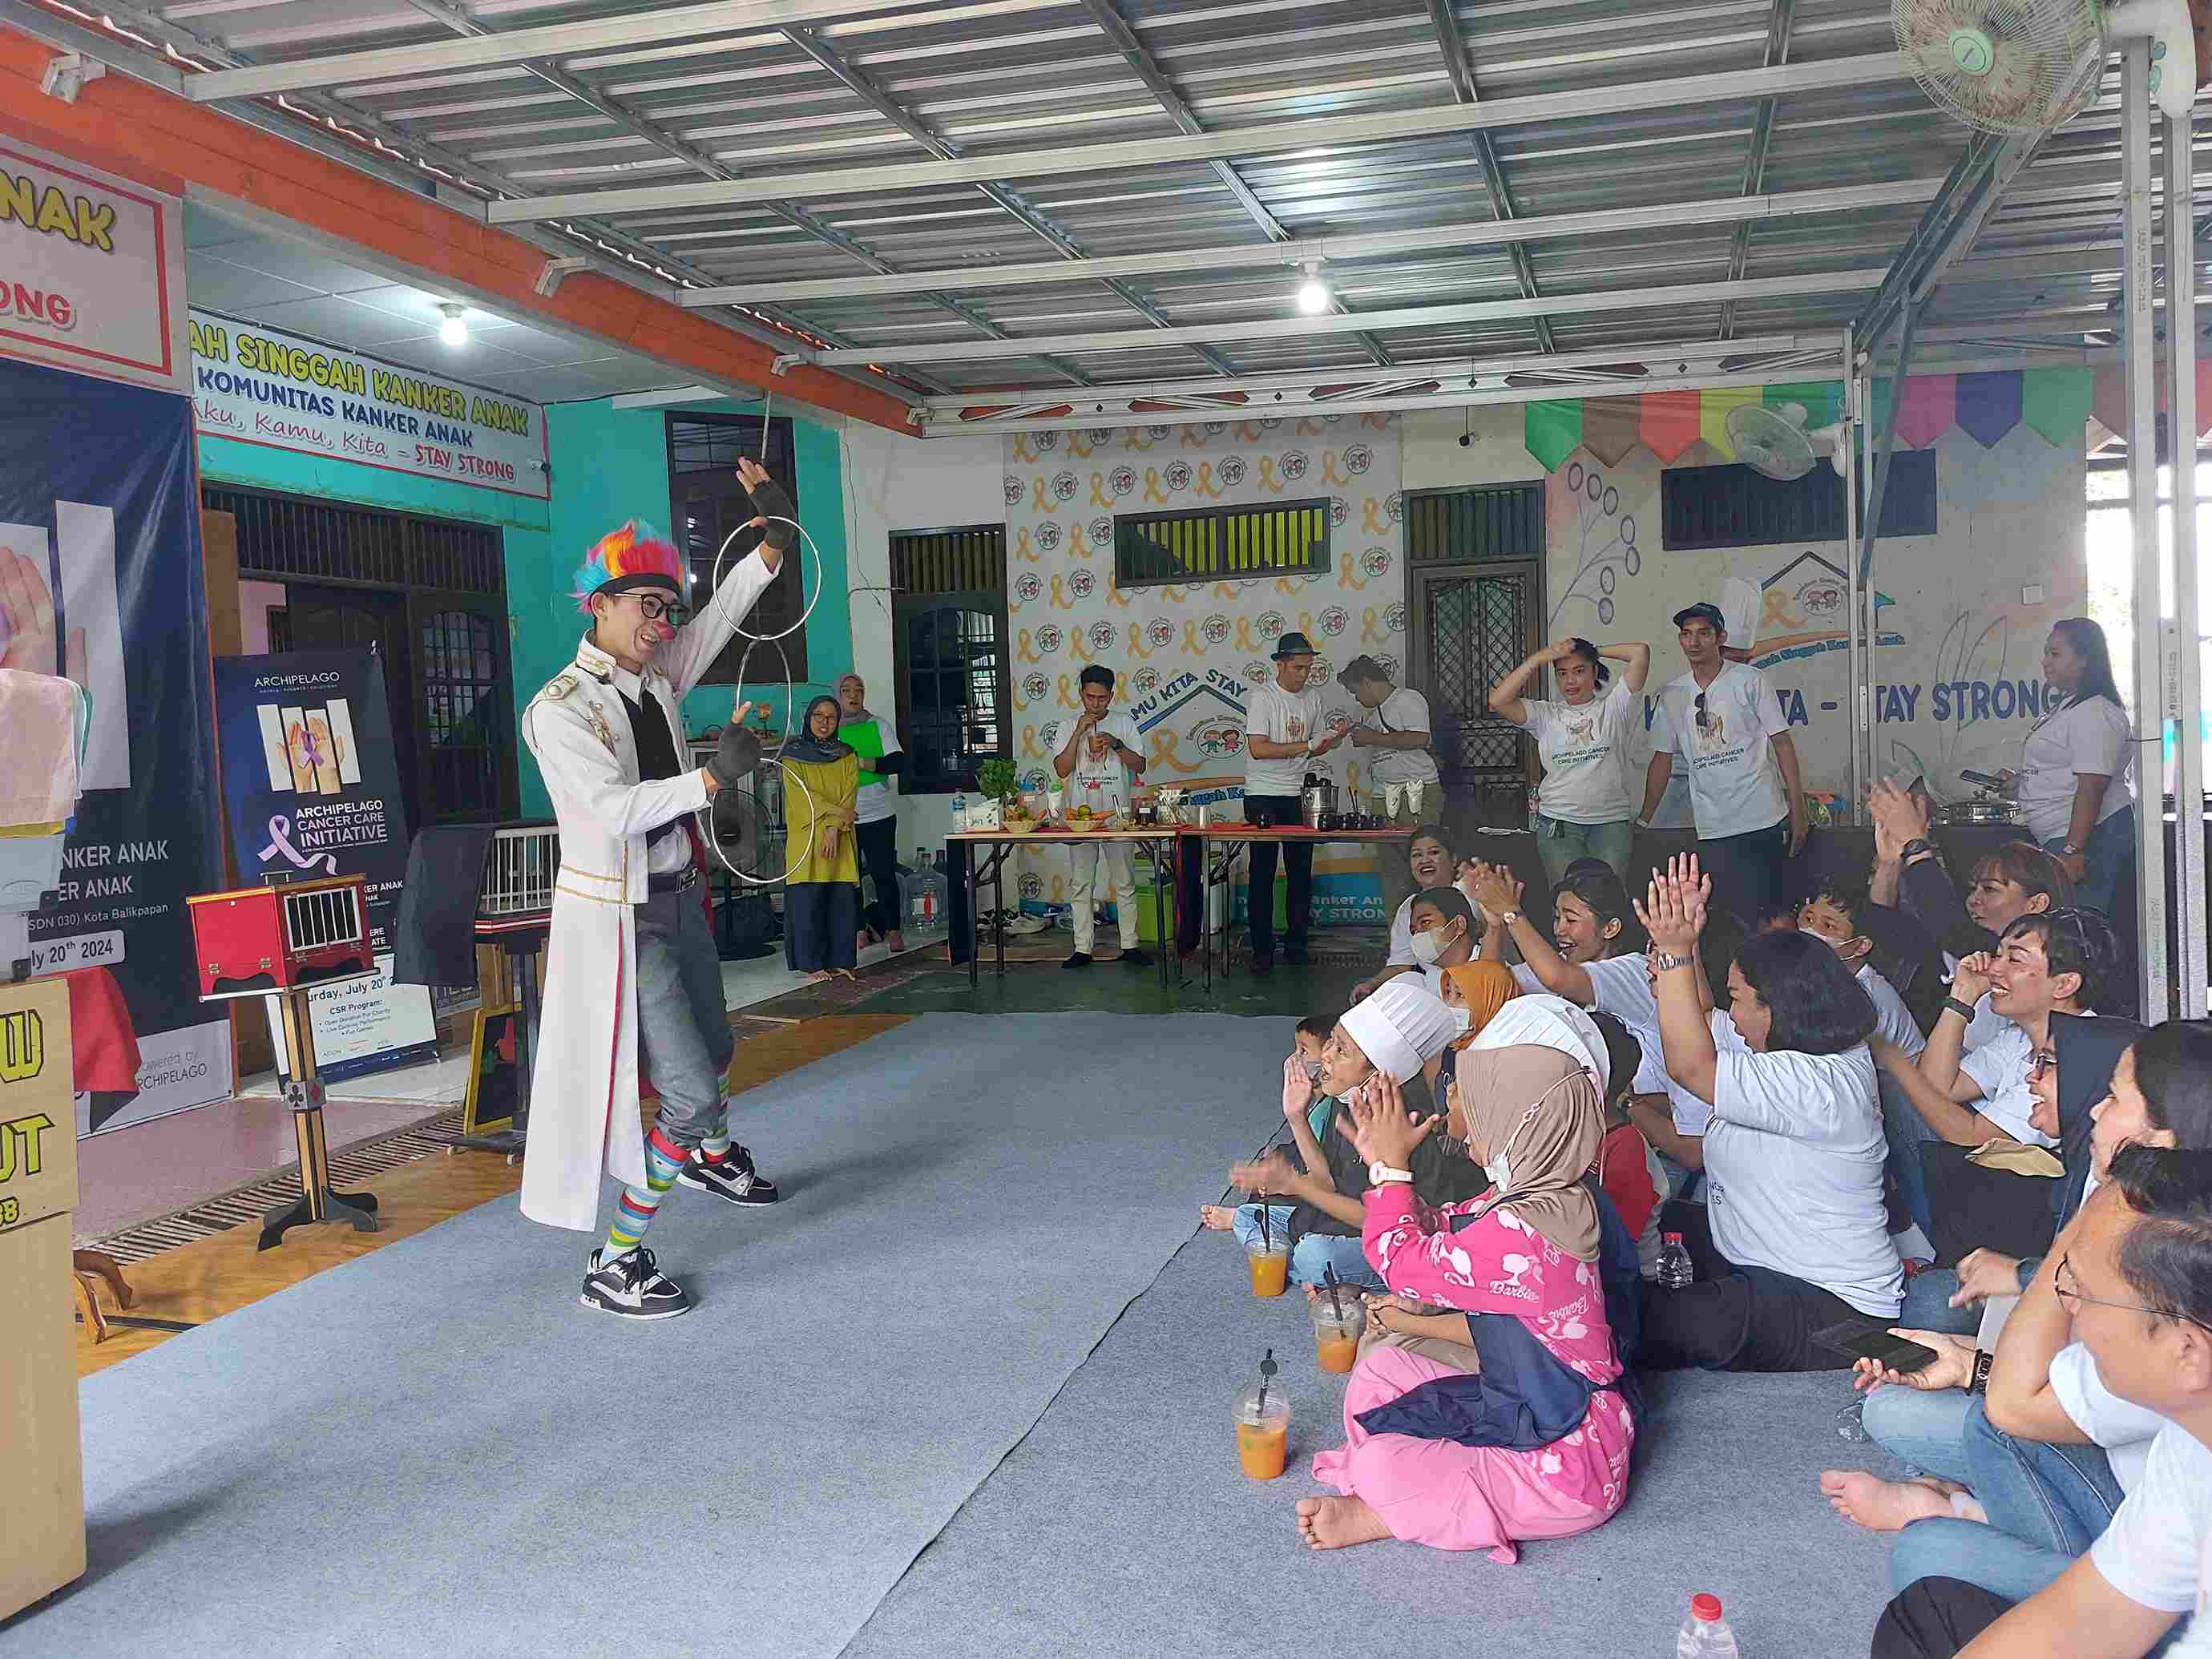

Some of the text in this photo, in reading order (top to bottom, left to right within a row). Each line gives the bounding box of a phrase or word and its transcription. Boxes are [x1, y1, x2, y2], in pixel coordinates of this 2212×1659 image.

[236, 333, 366, 396] SINGGAH
[372, 369, 466, 422] KANKER
[470, 396, 529, 438] ANAK
[198, 367, 474, 448] KOMUNITAS KANKER ANAK
[255, 411, 333, 448] Kamu,
[342, 430, 386, 455] Kita
[415, 444, 452, 468] STAY
[458, 453, 515, 480] STRONG
[254, 672, 340, 688] ARCHIPELAGO
[1159, 672, 1199, 700] KITA
[1205, 668, 1248, 698] STAY
[296, 799, 383, 819] ARCHIPELAGO
[297, 811, 385, 831] CANCER CARE
[300, 824, 388, 847] INITIATIVE
[117, 840, 169, 864] ANAK
[85, 875, 135, 898] ANAK
[380, 879, 403, 891] ANAK
[58, 914, 80, 927] 030)
[84, 910, 109, 923] Kota
[111, 903, 168, 920] Balikpapan
[49, 941, 76, 964] 20th
[81, 938, 114, 959] 2024
[346, 982, 368, 995] July
[329, 1005, 346, 1015] CSR
[1487, 1279, 1540, 1303] Barbie
